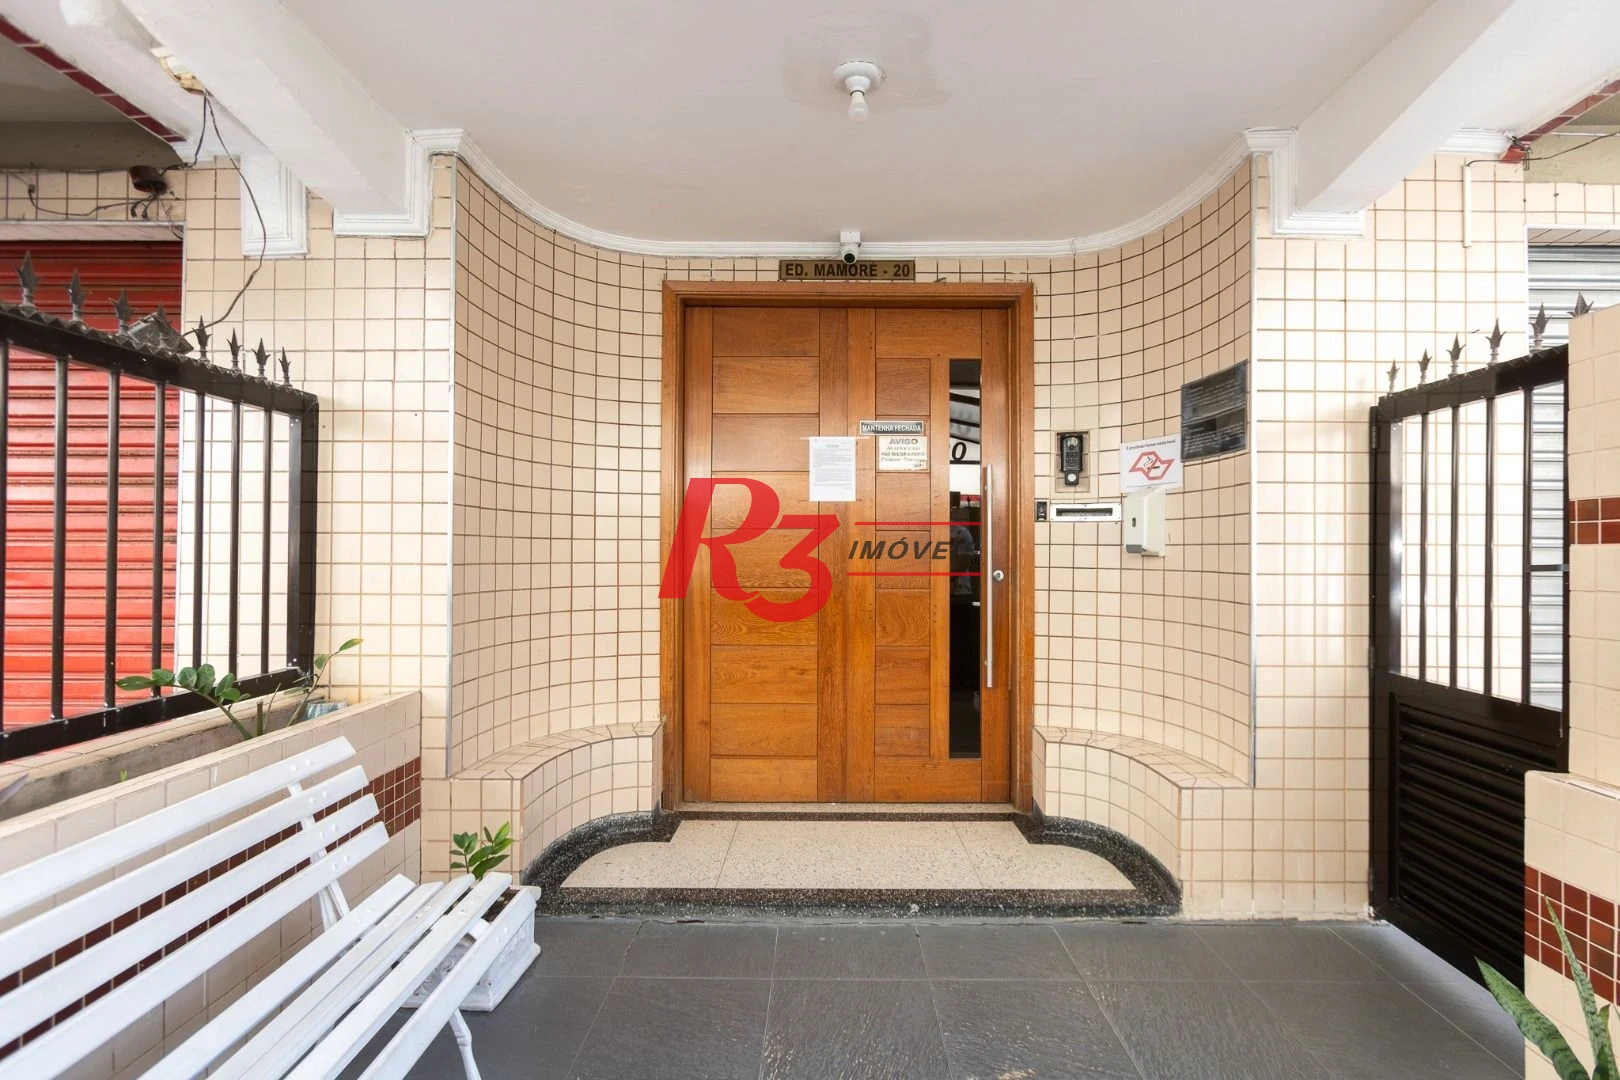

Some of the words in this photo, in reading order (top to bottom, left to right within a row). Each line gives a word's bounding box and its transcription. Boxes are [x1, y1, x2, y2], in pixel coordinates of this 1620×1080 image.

[785, 263, 808, 277] ED.
[893, 263, 910, 277] 20
[862, 424, 893, 432] MANTENHA
[894, 424, 921, 432] FECHADA
